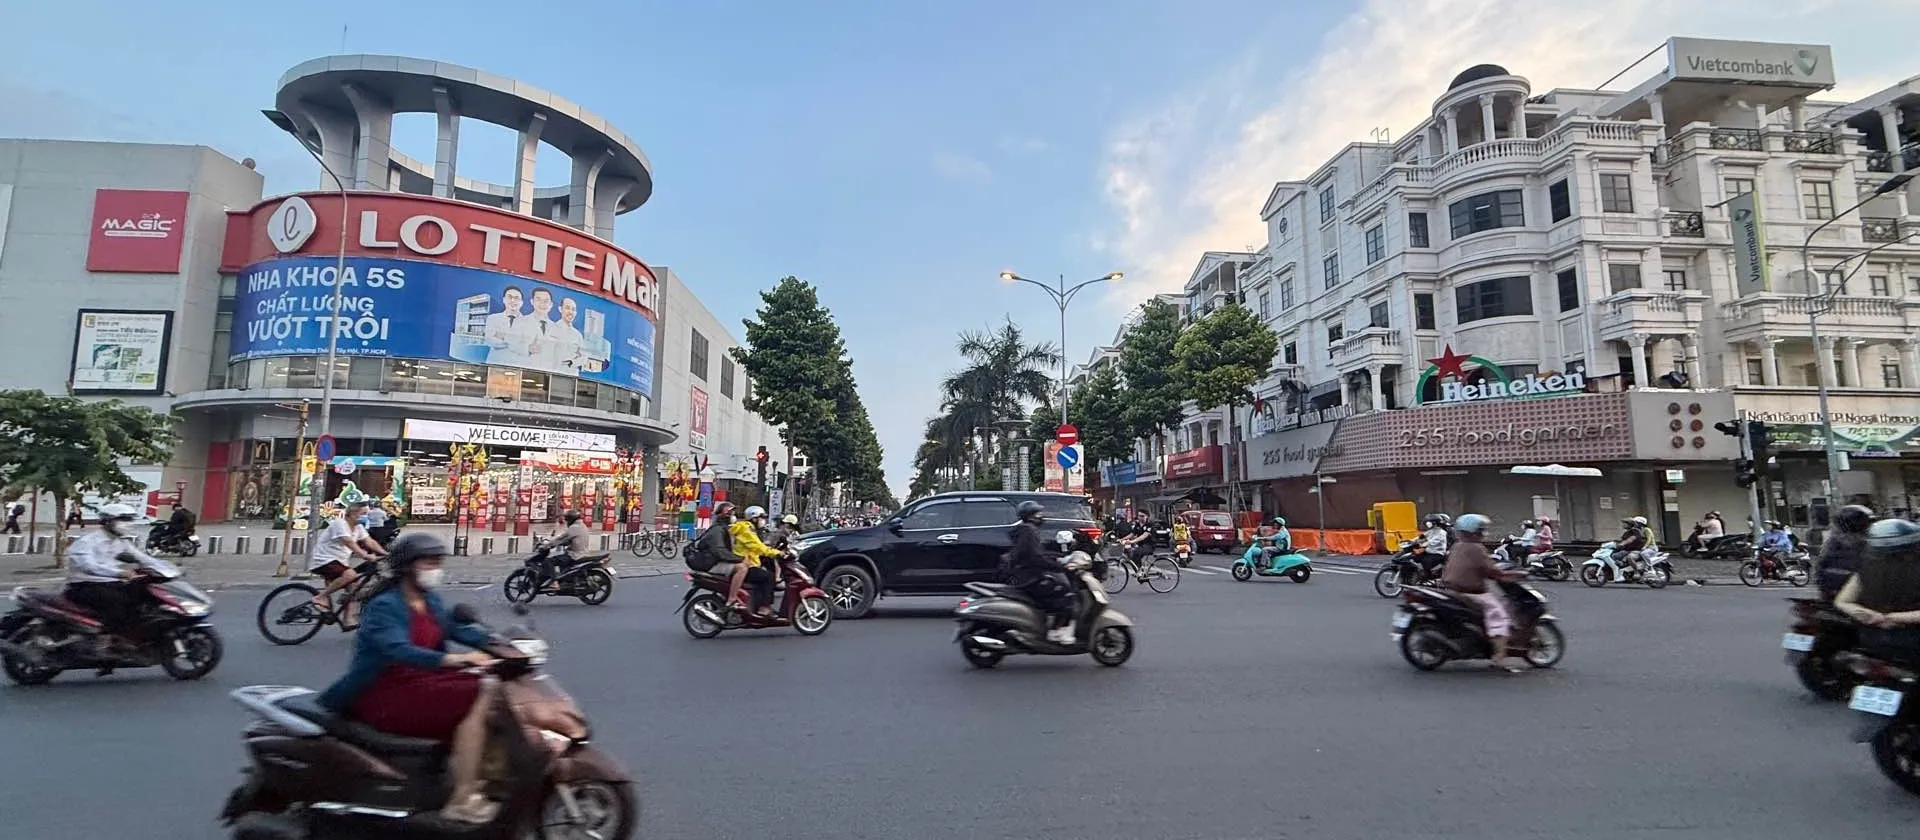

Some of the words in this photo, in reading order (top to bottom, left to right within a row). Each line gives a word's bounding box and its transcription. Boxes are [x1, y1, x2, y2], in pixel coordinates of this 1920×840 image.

[1687, 55, 1794, 77] Vietcombank
[101, 217, 172, 231] MAGIC
[359, 210, 597, 286] LOTTE
[1748, 221, 1761, 283] Vietcombank
[247, 270, 281, 294] NHA
[286, 266, 359, 288] KHOA
[366, 267, 405, 289] 5S
[256, 291, 298, 315] CHẤT
[247, 315, 308, 346] VƯỢT
[315, 311, 389, 346] TRỘI
[1440, 365, 1586, 401] Heineken
[469, 427, 547, 444] WELCOME!
[1399, 427, 1446, 448] 255
[1455, 423, 1514, 446] food
[1519, 421, 1617, 448] garden
[1262, 448, 1280, 466] 255
